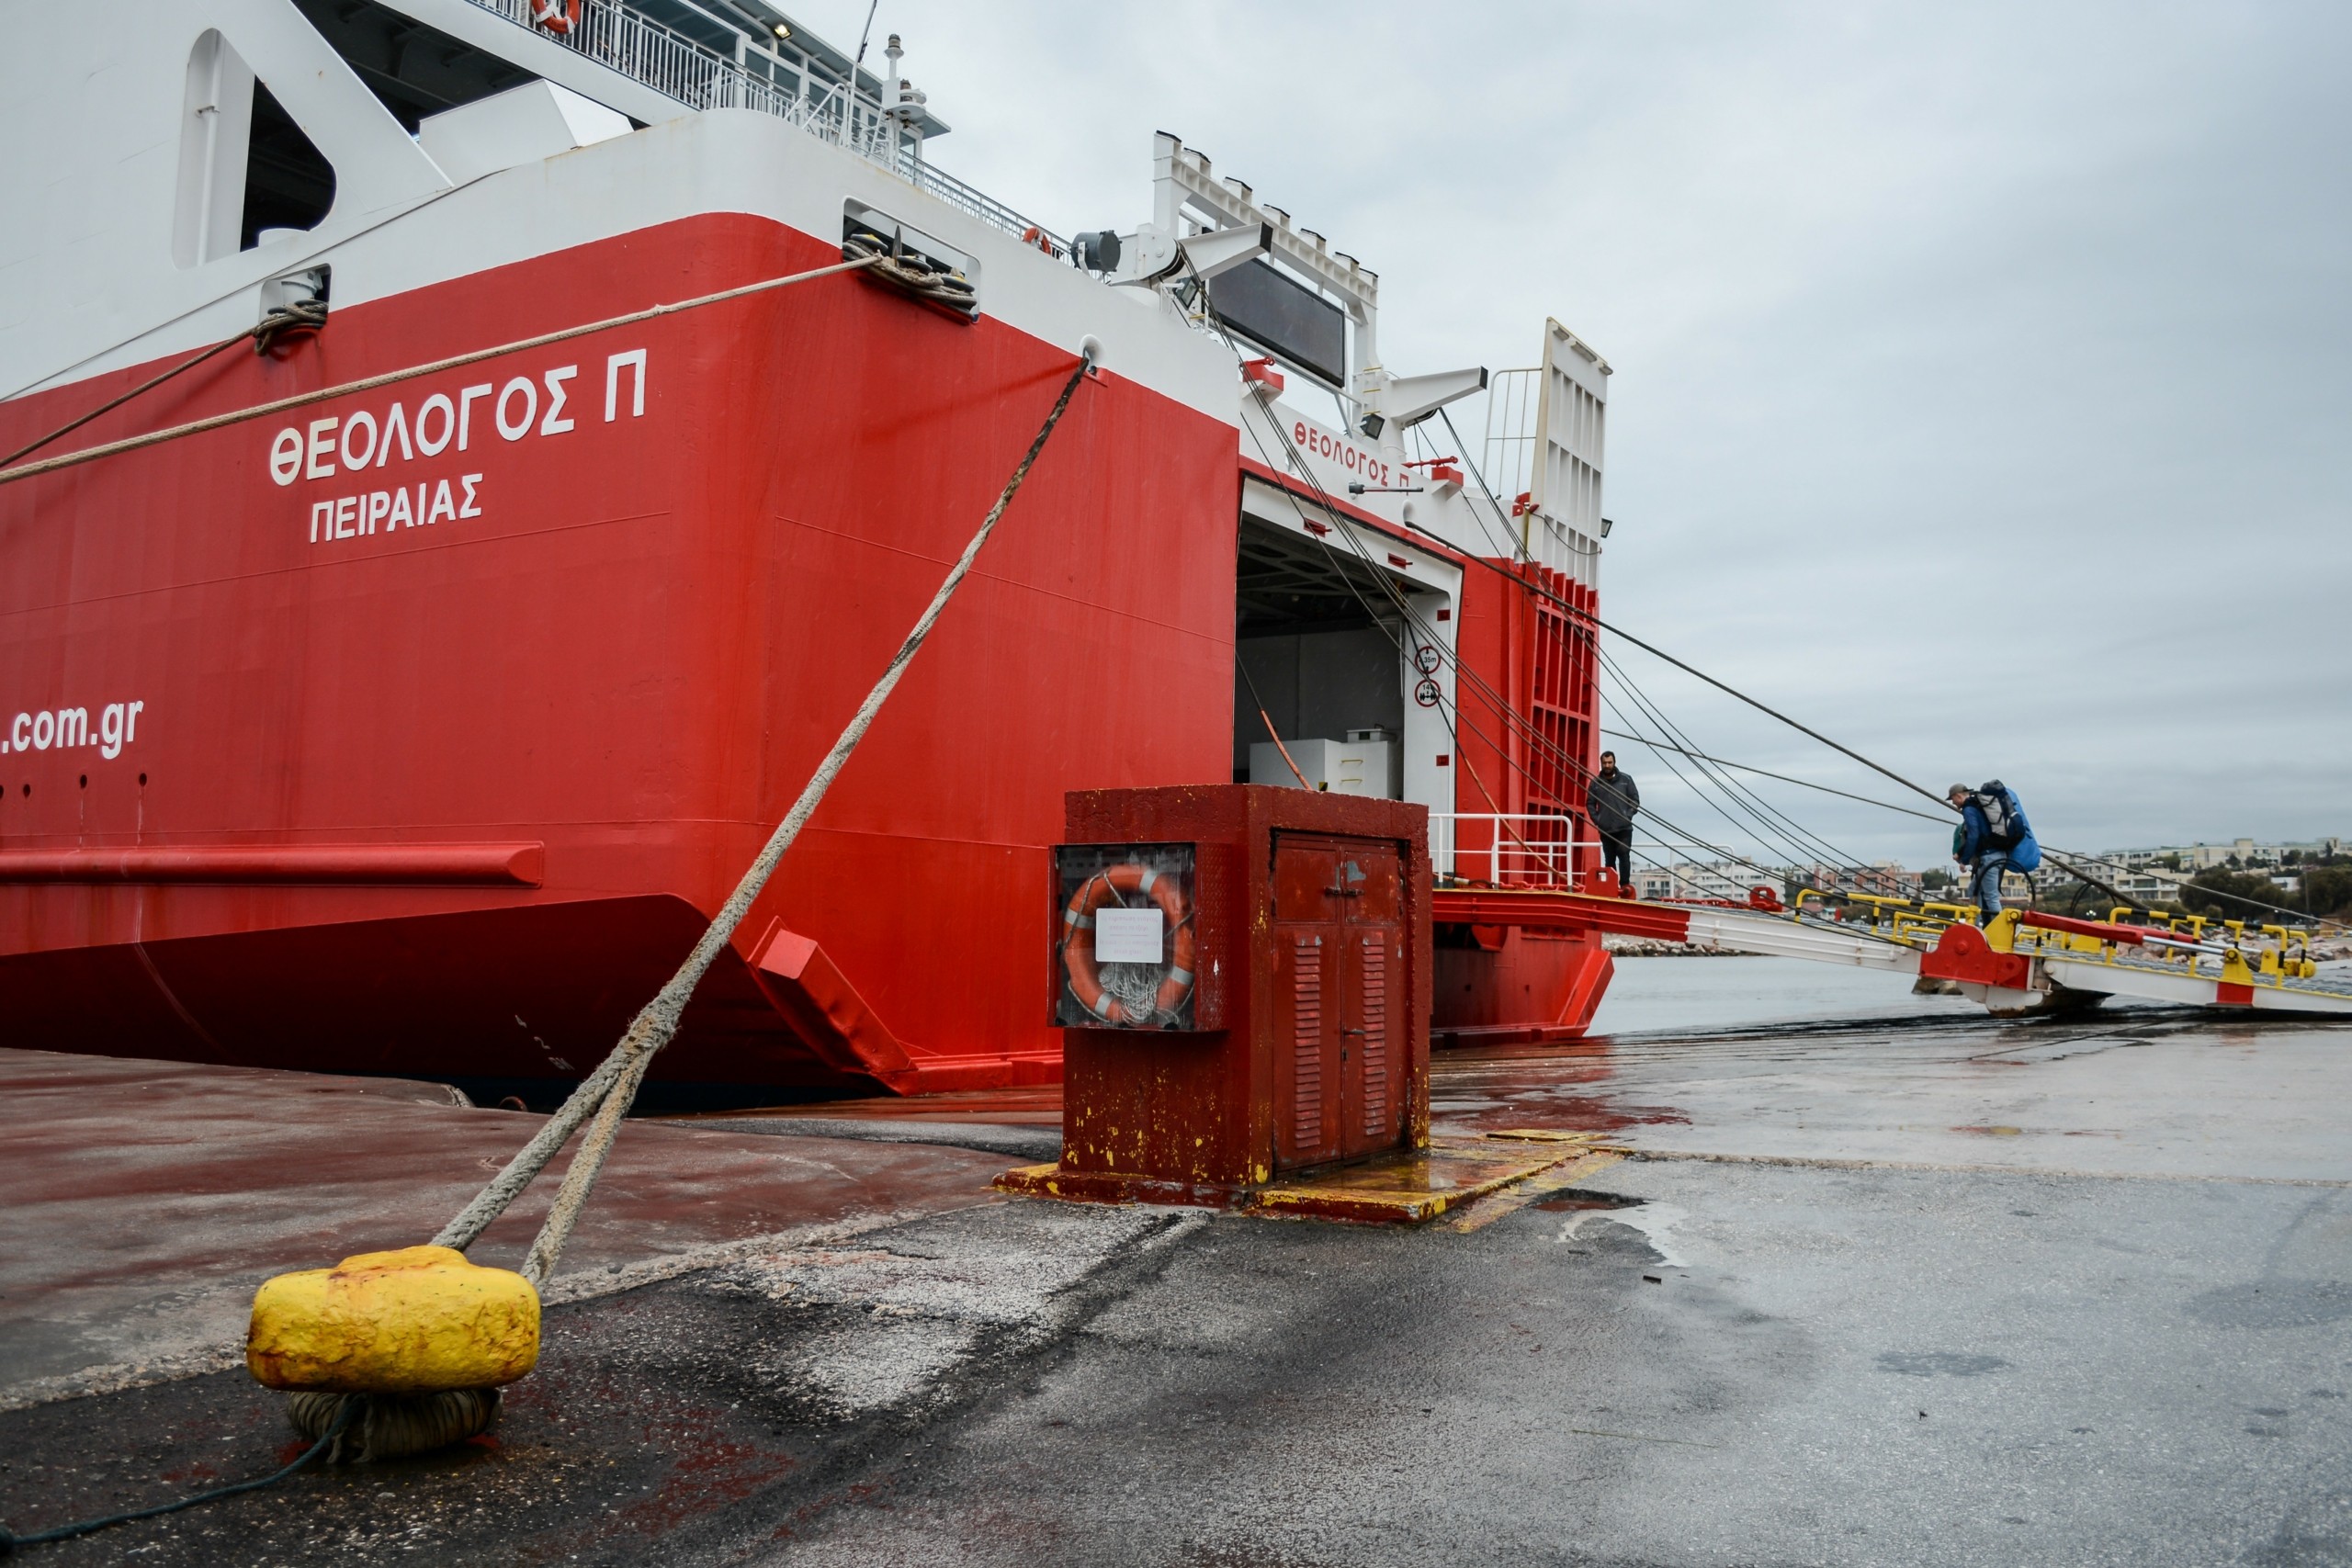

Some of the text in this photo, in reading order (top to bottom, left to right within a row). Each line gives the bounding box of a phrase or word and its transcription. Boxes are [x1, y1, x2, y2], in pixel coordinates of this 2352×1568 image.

[270, 348, 647, 487] ΘΕΟΛΟΓΟΣ Π
[1295, 422, 1388, 487] ΘΕΟΛΟΓΟΣ
[310, 473, 483, 544] ΠΕΙΡΑΙΑΣ
